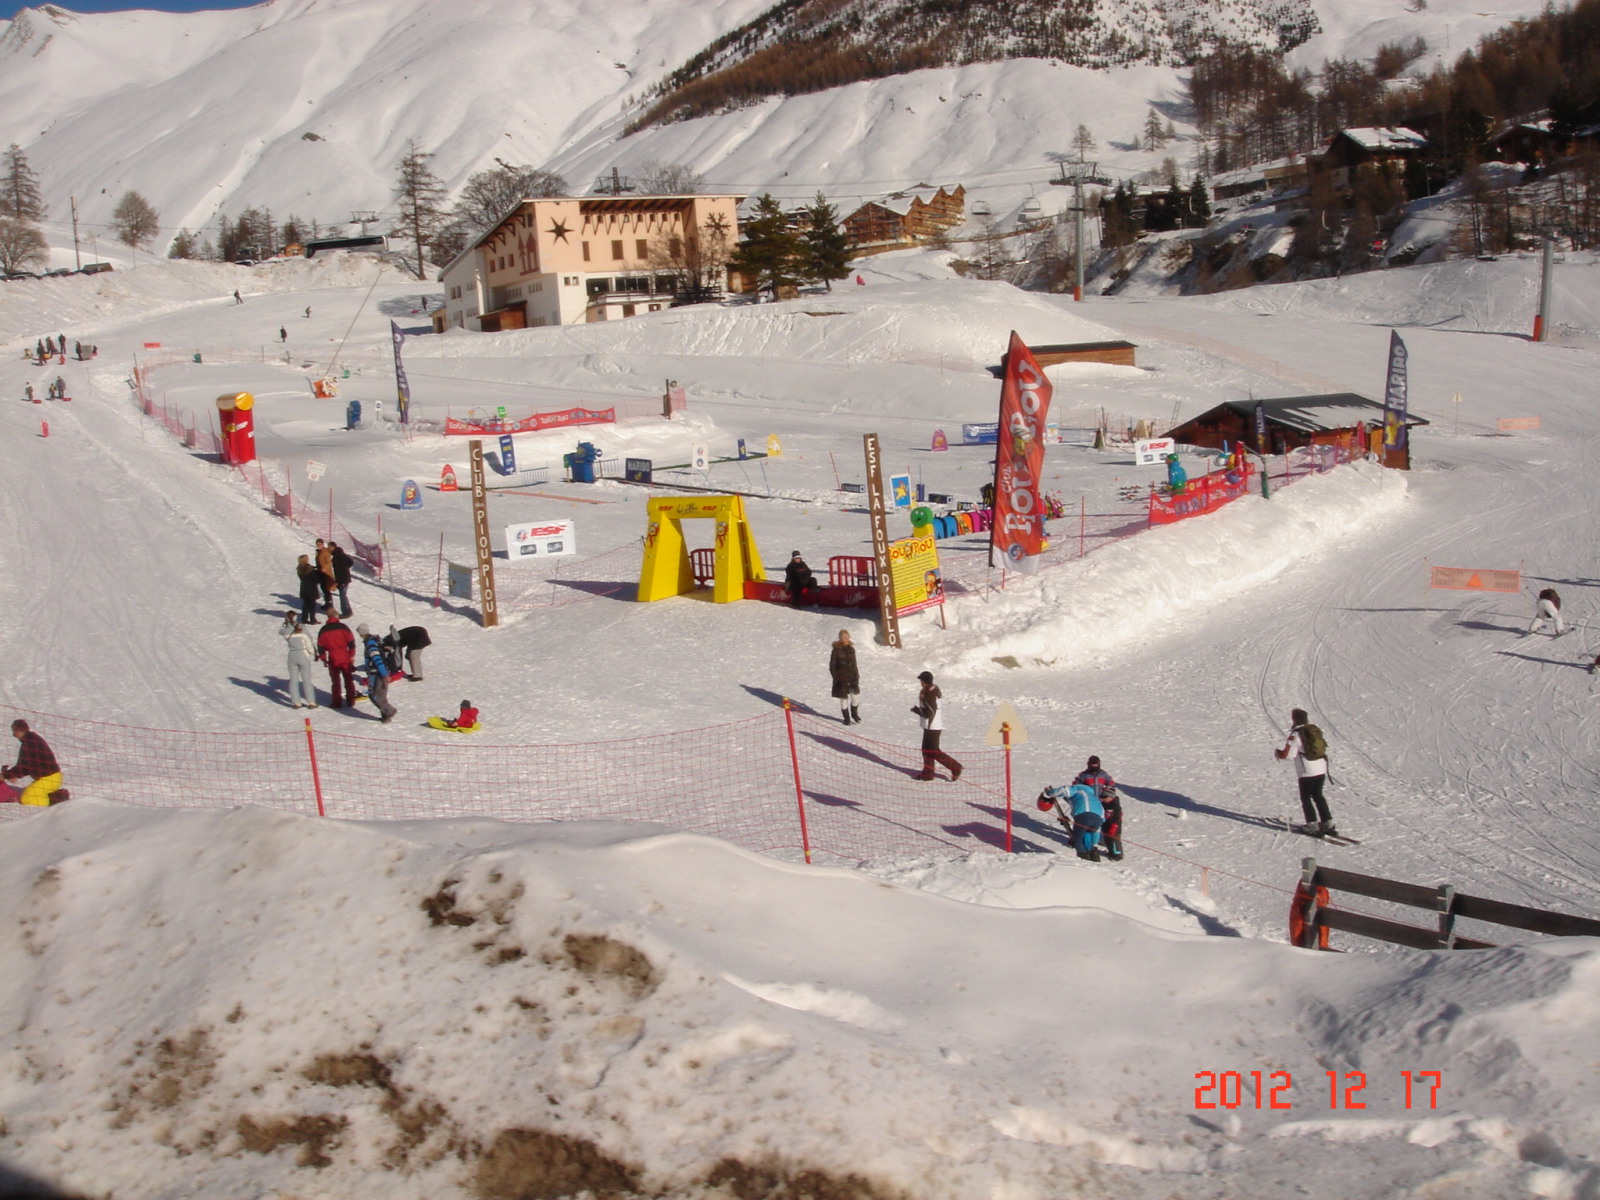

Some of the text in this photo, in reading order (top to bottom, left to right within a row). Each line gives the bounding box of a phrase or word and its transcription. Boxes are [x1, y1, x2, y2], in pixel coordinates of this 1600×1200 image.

[1387, 345, 1406, 410] HARIBO
[472, 448, 484, 498] CLUB
[627, 459, 650, 473] HARIBO
[477, 510, 490, 560] PIOU
[866, 437, 898, 649] ESF LA FOUX D'ALLO
[482, 564, 495, 613] PIOU
